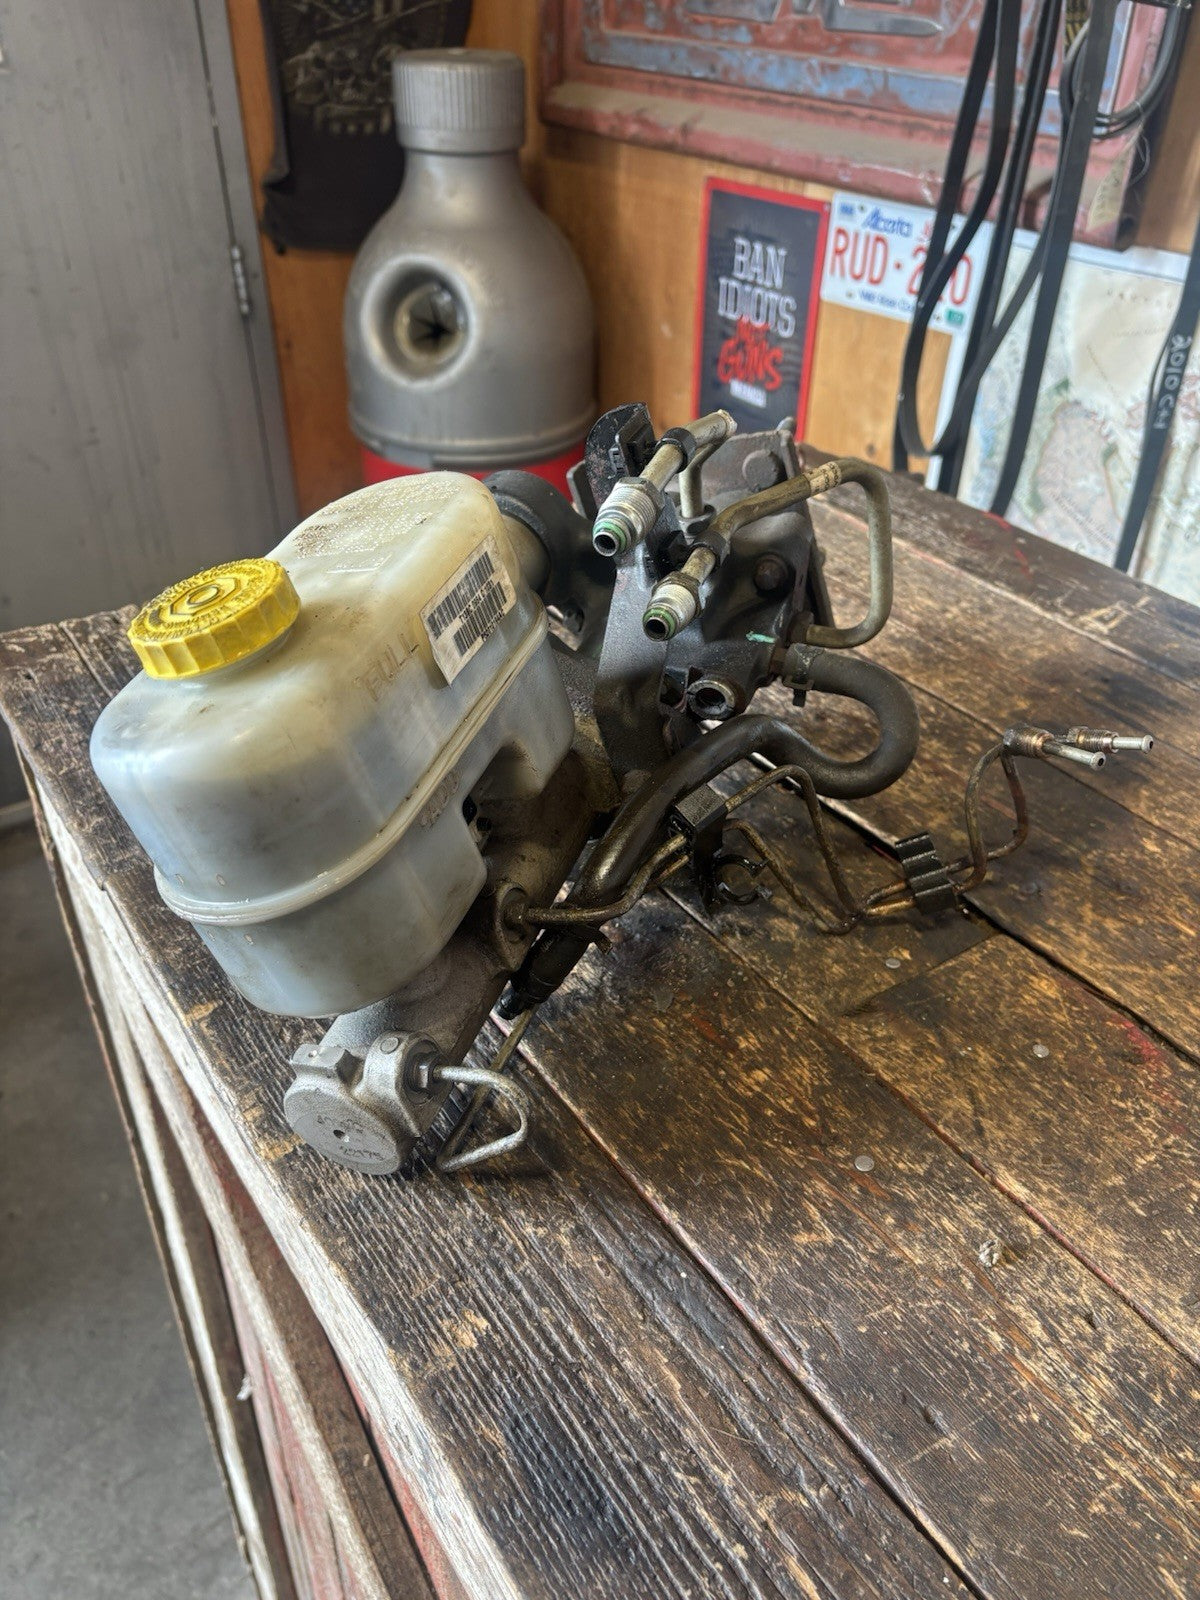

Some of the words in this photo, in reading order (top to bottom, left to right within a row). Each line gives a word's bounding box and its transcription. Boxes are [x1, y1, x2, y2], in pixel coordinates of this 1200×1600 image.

[732, 235, 787, 289] BAN
[829, 226, 888, 285] RUD
[717, 276, 797, 338] IDIOTS
[717, 334, 783, 391] GUNS
